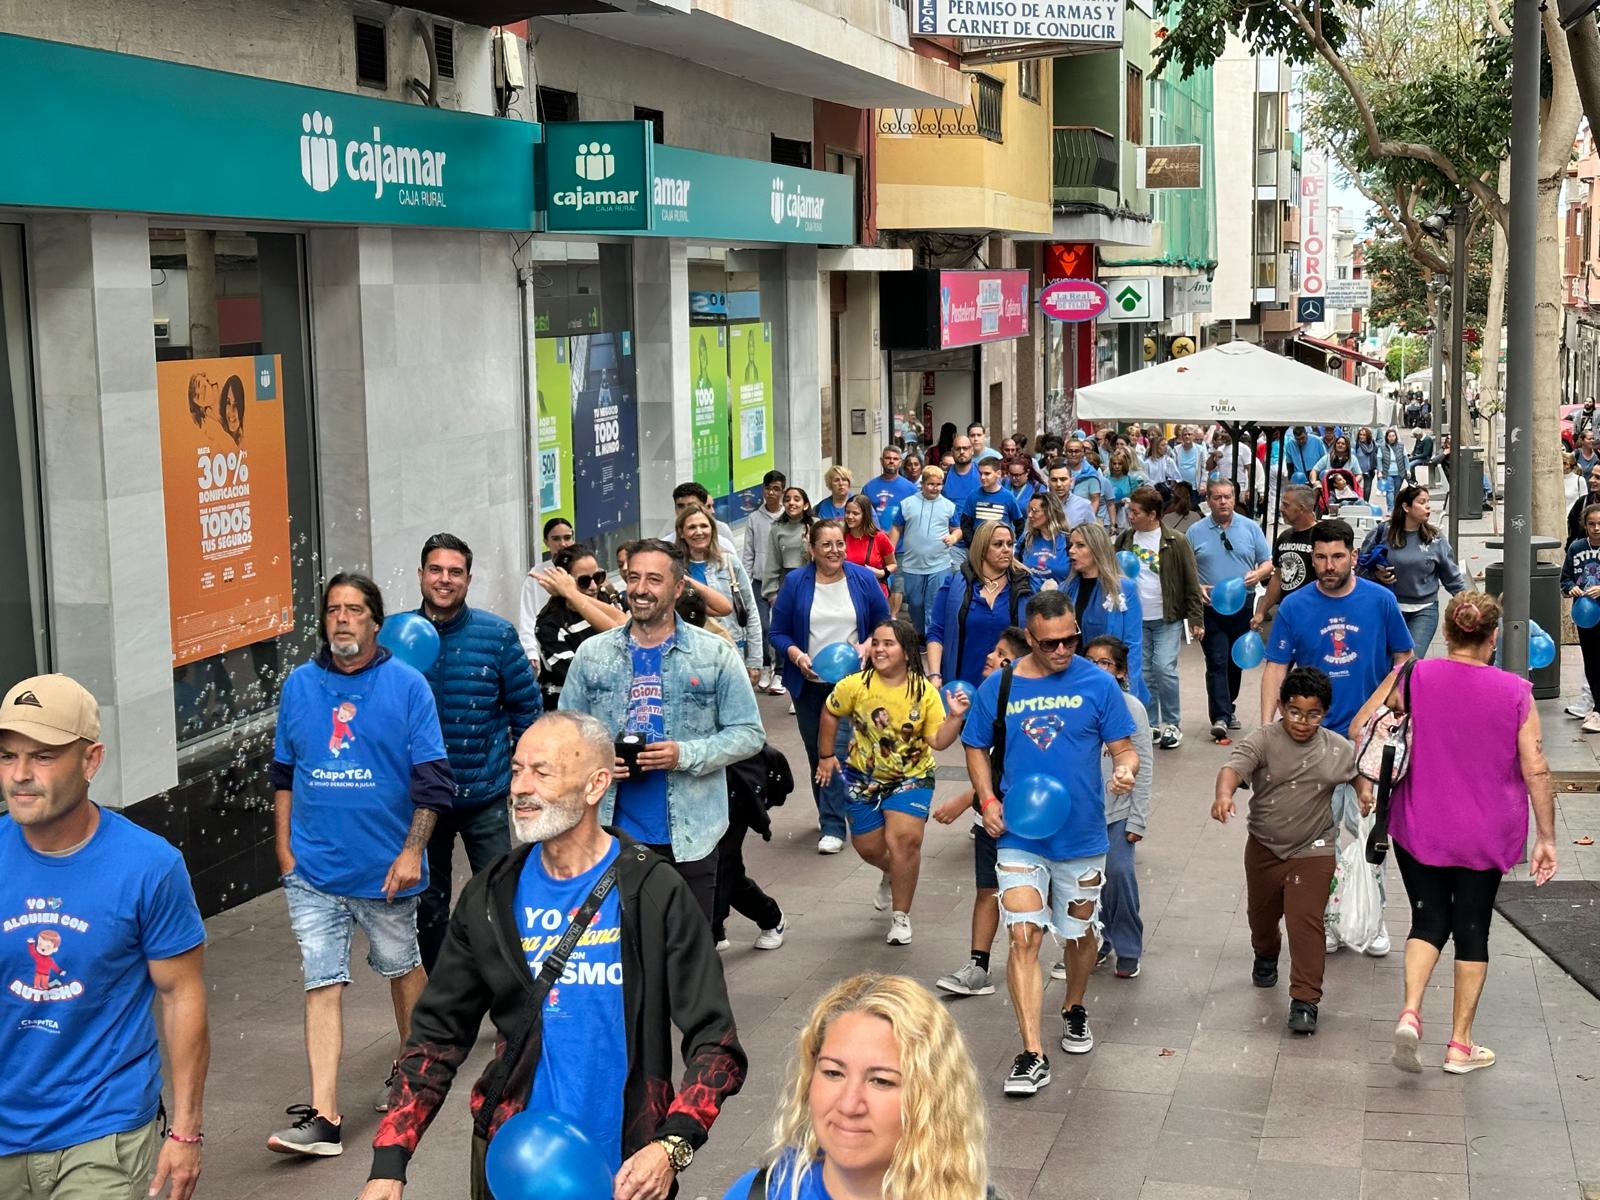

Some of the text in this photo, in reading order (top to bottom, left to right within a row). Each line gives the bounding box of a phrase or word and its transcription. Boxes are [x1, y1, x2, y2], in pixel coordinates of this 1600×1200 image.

[948, 0, 1116, 20] PERMISO DE ARMAS Y
[947, 18, 1116, 39] CARNET DE CONDUCIR
[345, 126, 446, 199] cajamar
[399, 189, 447, 208] CAJA RURAL
[553, 185, 640, 211] cajamar
[653, 176, 691, 208] amar
[786, 184, 825, 228] cajamar
[593, 419, 619, 444] TODO
[200, 506, 251, 540] TODOS
[201, 539, 216, 554] TUS
[218, 530, 253, 551] SEGUROS
[1005, 694, 1084, 717] AUTISMO
[312, 768, 373, 781] ChapoTEA
[27, 897, 46, 910] YO
[3, 912, 89, 934] ALGUIEN CON
[524, 906, 563, 931] YO
[10, 979, 84, 1002] AUTISMO
